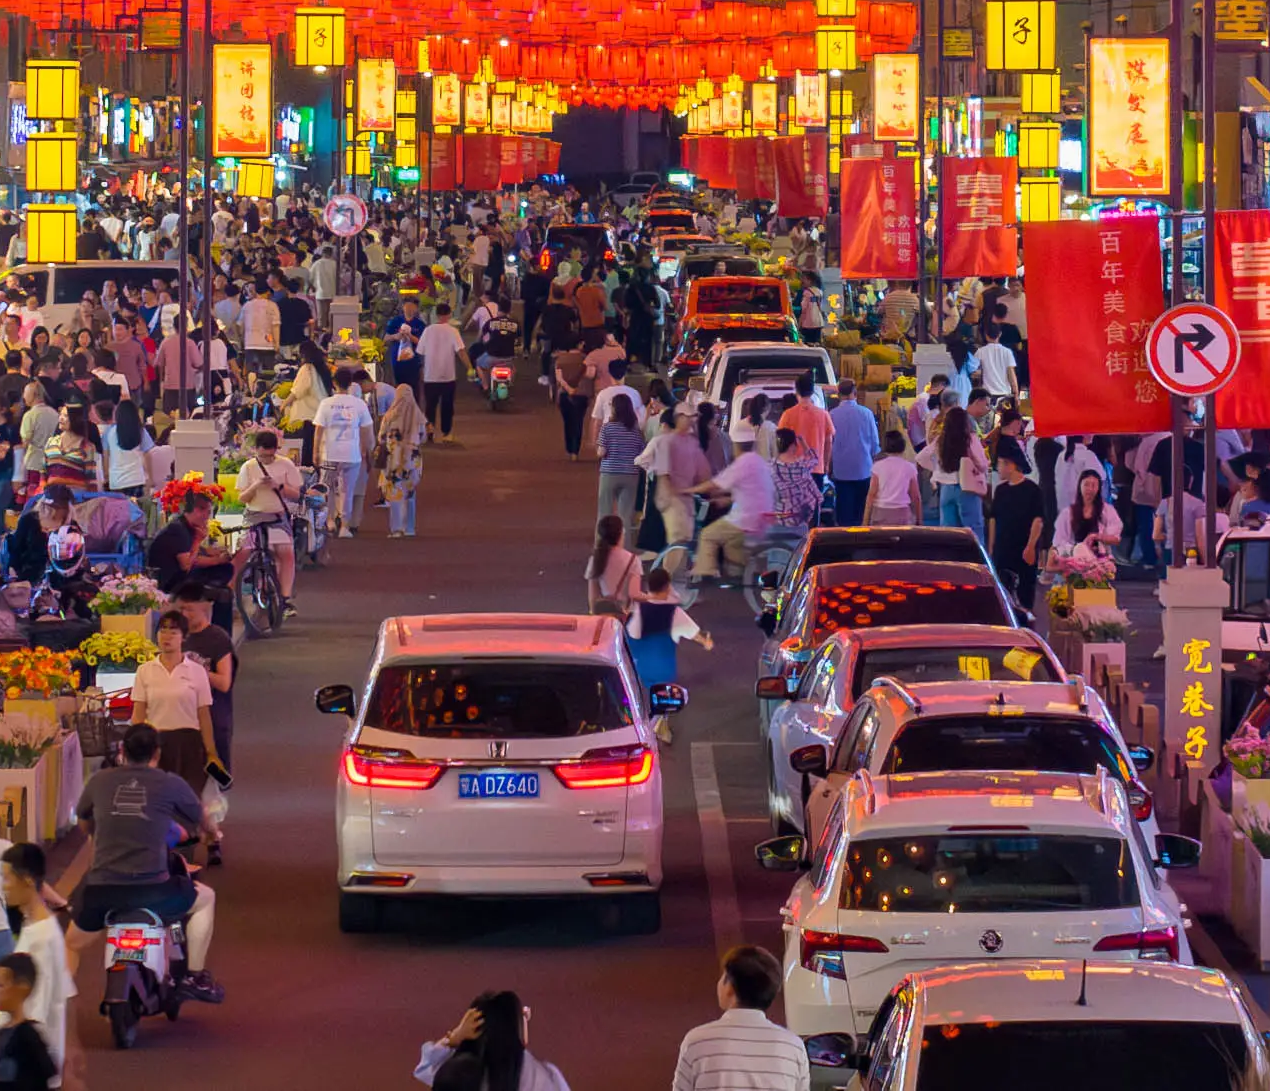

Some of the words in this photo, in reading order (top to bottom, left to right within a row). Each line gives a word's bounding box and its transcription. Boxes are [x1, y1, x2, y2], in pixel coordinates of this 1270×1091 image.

[1013, 17, 1032, 44] 子
[239, 61, 255, 122] 讲团结
[1126, 59, 1150, 146] 谋发展
[1098, 230, 1128, 376] 百年美食街
[1180, 638, 1214, 760] 宽巷子
